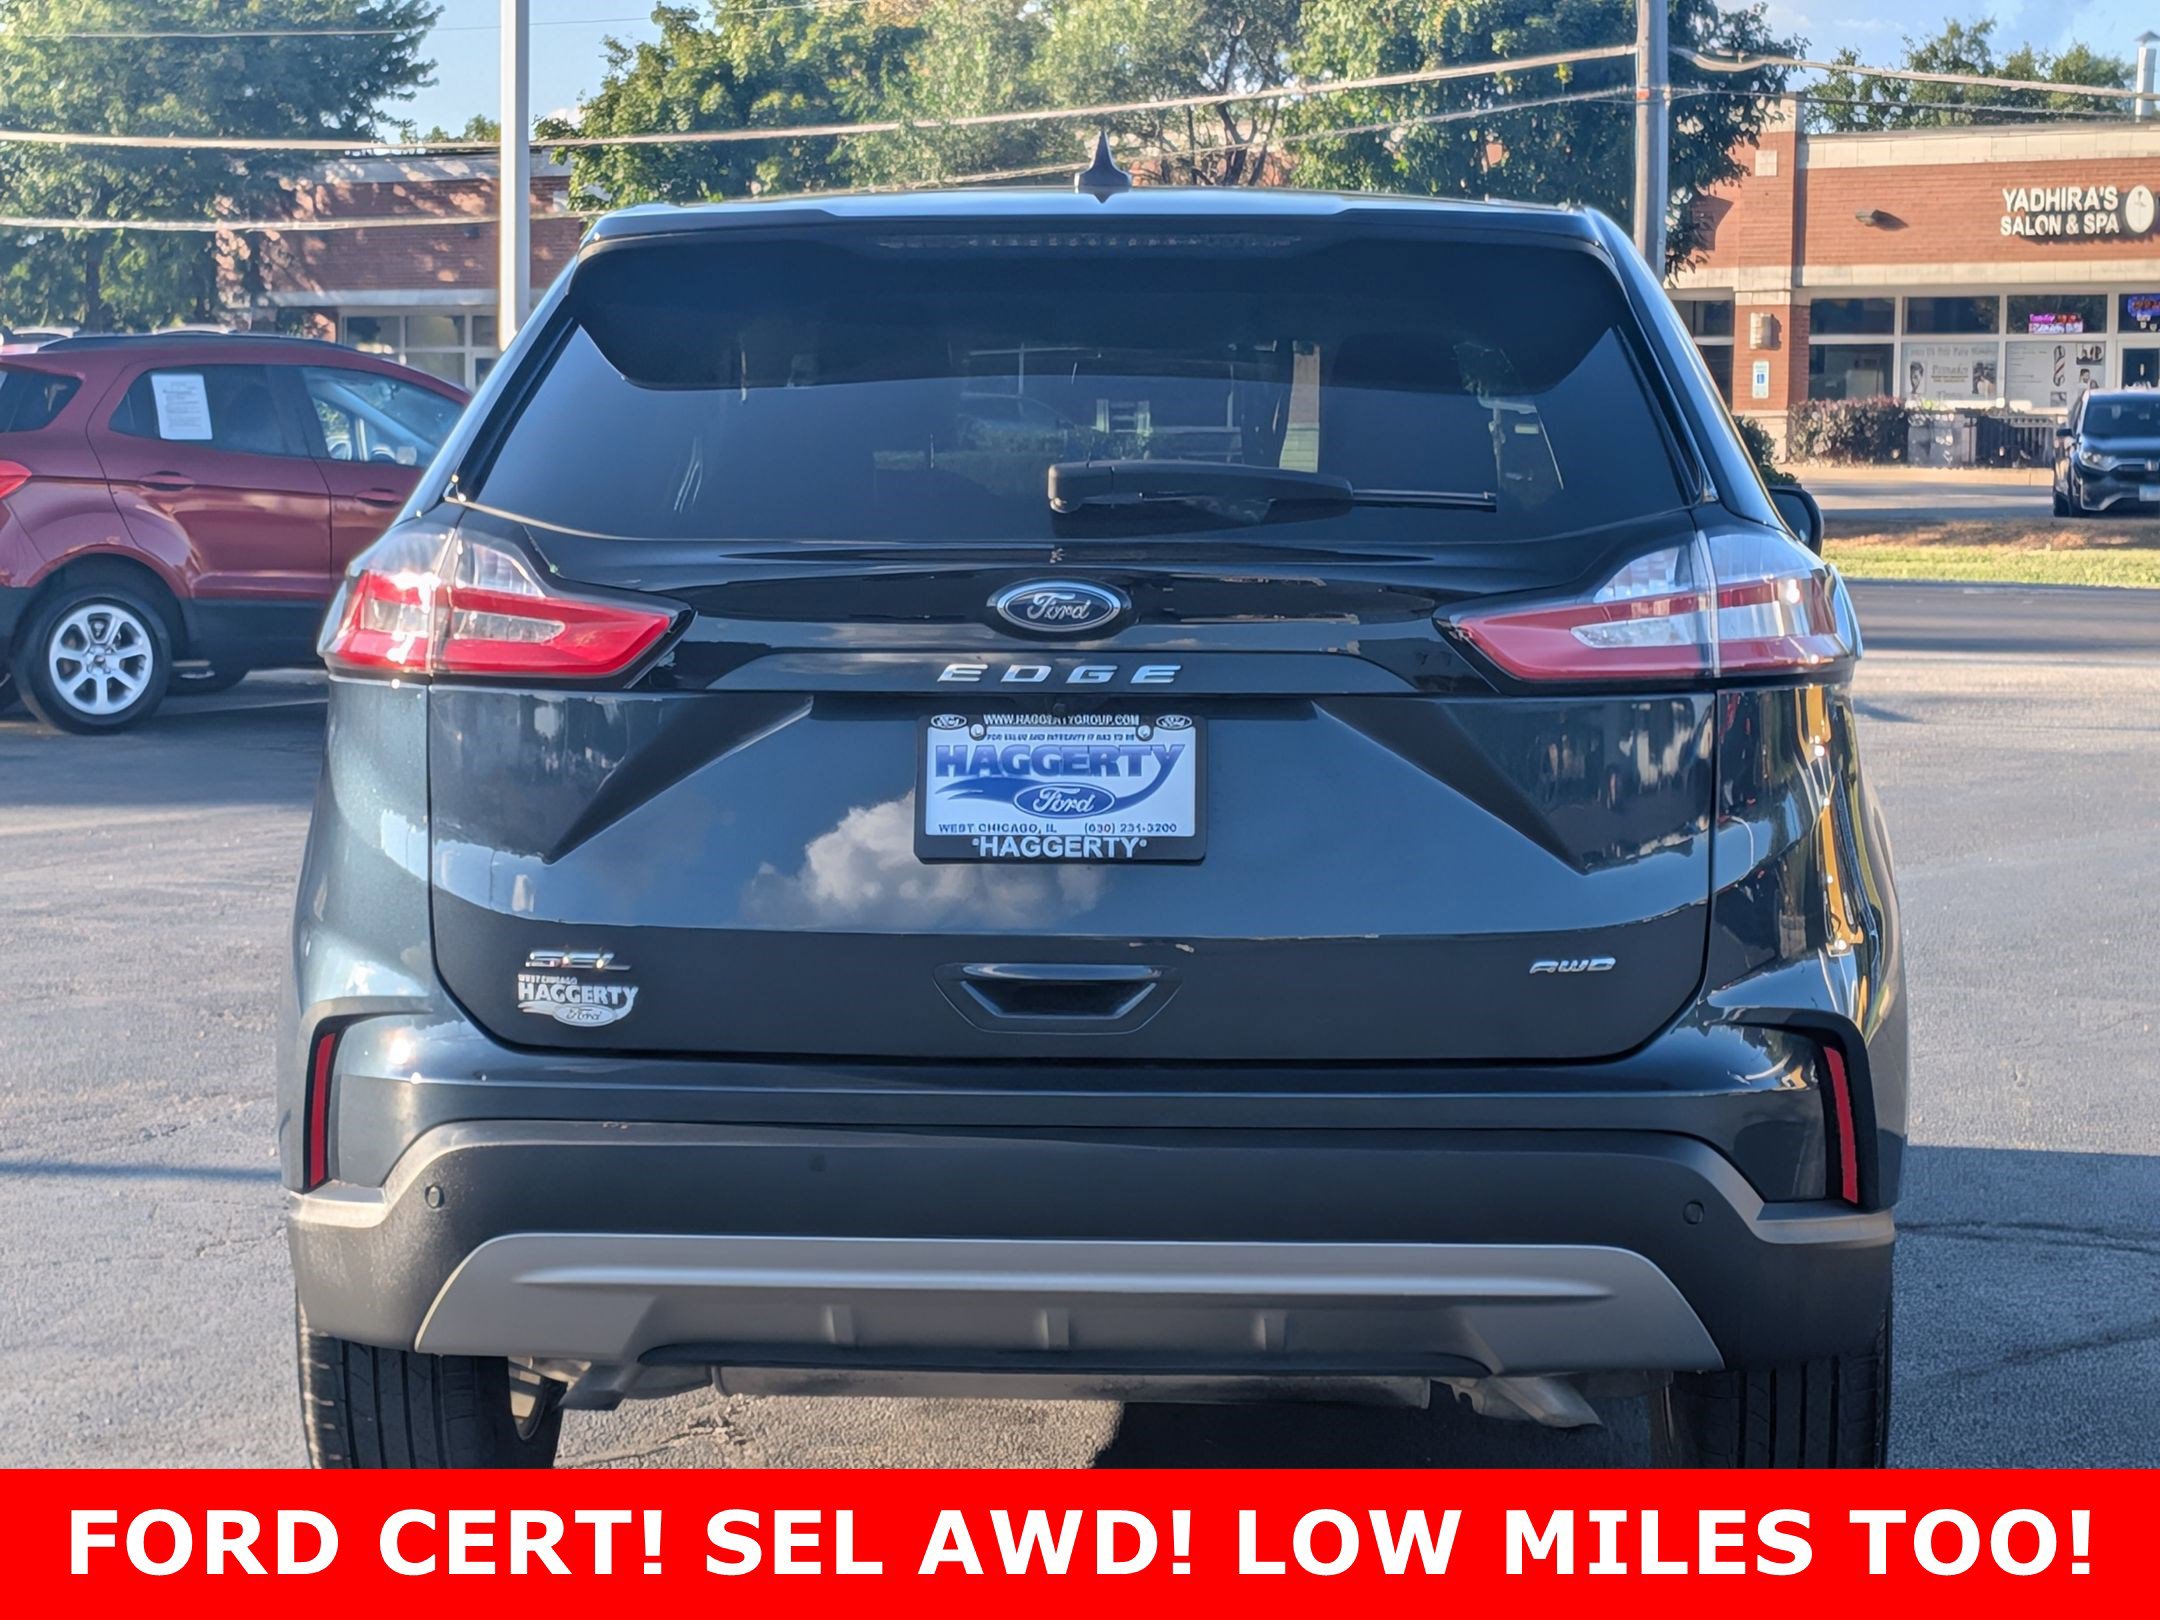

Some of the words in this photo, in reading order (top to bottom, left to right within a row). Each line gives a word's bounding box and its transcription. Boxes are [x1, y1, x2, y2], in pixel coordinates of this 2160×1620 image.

[2002, 186, 2119, 212] YADHIRA'S
[2000, 214, 2062, 236] SALON
[2065, 213, 2079, 235] &
[2083, 212, 2120, 234] SPA
[1027, 592, 1092, 619] Ford
[937, 663, 1182, 684] EDGE
[935, 744, 1185, 777] HAGGERTY
[1032, 787, 1095, 813] Ford
[939, 823, 975, 833] WEST
[978, 823, 1042, 835] CHICAGO,
[1046, 823, 1057, 833] IL
[1120, 823, 1178, 833] 231-3200
[980, 836, 1140, 858] HAGGERTY
[525, 951, 631, 970] SEL
[1529, 957, 1616, 974] AWD
[518, 973, 540, 983] WEST
[541, 975, 578, 985] CHICAGO
[518, 981, 639, 1005] HAGGERTY
[566, 1006, 602, 1020] Ford
